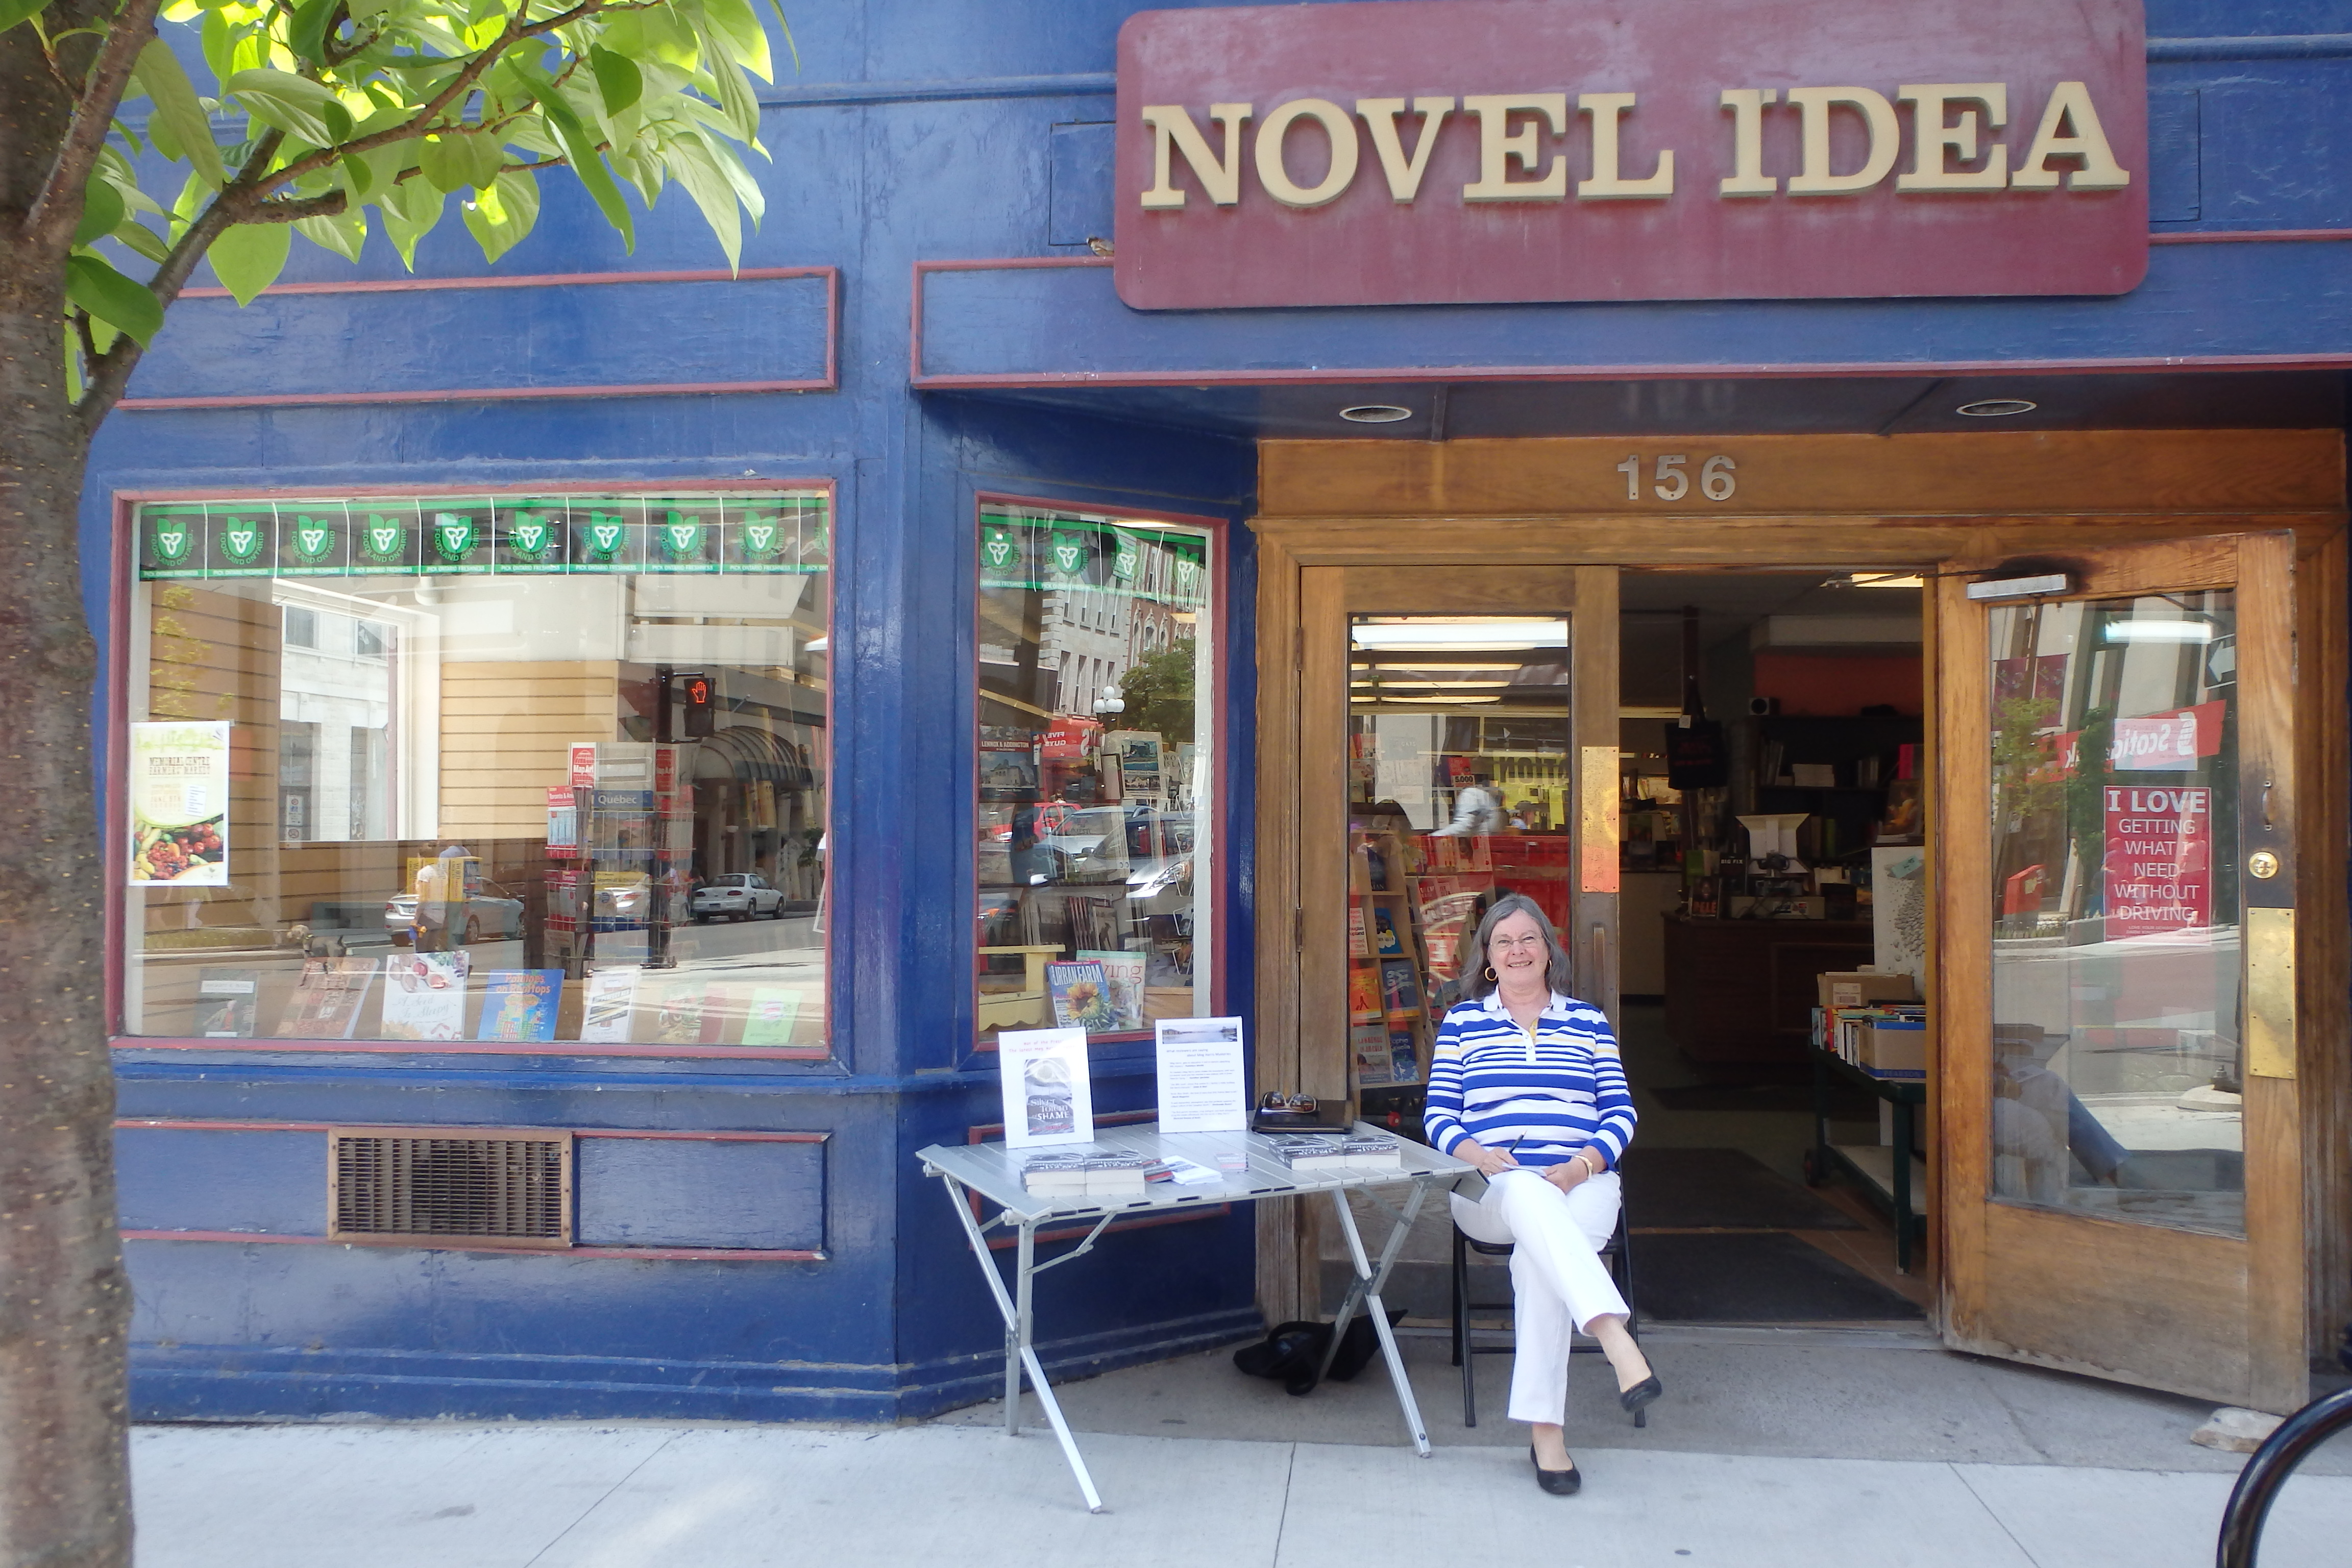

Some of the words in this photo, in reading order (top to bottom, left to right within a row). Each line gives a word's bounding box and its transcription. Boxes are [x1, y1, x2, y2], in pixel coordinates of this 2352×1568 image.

[1140, 92, 1674, 207] NOVEL
[1719, 81, 2130, 197] IDEA
[1616, 454, 1737, 501] 156
[151, 534, 175, 566] FOODLAND
[177, 533, 193, 566] ONTARIO
[220, 532, 244, 565] FOODLAND
[246, 532, 264, 564] ONTARIO
[291, 531, 315, 564] FOODLAND
[316, 531, 335, 562] ONTARIO
[363, 530, 387, 562] FOODLAND
[388, 529, 407, 561] ONTARIO
[434, 528, 459, 561] FOODLAND
[460, 528, 480, 560] ONTARIO
[583, 527, 609, 560] FOODLAND
[611, 527, 630, 559] ONTARIO
[660, 527, 686, 560] FOODLAND
[688, 527, 707, 559] ONTARIO
[150, 757, 183, 766] MEMORIAL
[186, 757, 210, 766] CENTRE
[184, 767, 210, 775] MARKET
[598, 794, 637, 805] Québec
[2109, 791, 2121, 812] I
[2132, 791, 2206, 813] LOVE
[2119, 818, 2195, 834] GETTING
[2125, 841, 2176, 855] WHAT
[2182, 841, 2188, 856] I
[2134, 863, 2180, 877] NEED
[2114, 884, 2200, 899] WITHOUT
[2120, 905, 2195, 921] DRIVING
[505, 972, 545, 983] Potatoes
[1054, 966, 1078, 986] URBAN
[1077, 964, 1103, 983] FARM
[509, 983, 551, 995] Rooftops
[413, 1004, 449, 1019] Sleepy
[1038, 1111, 1069, 1120] SHAME
